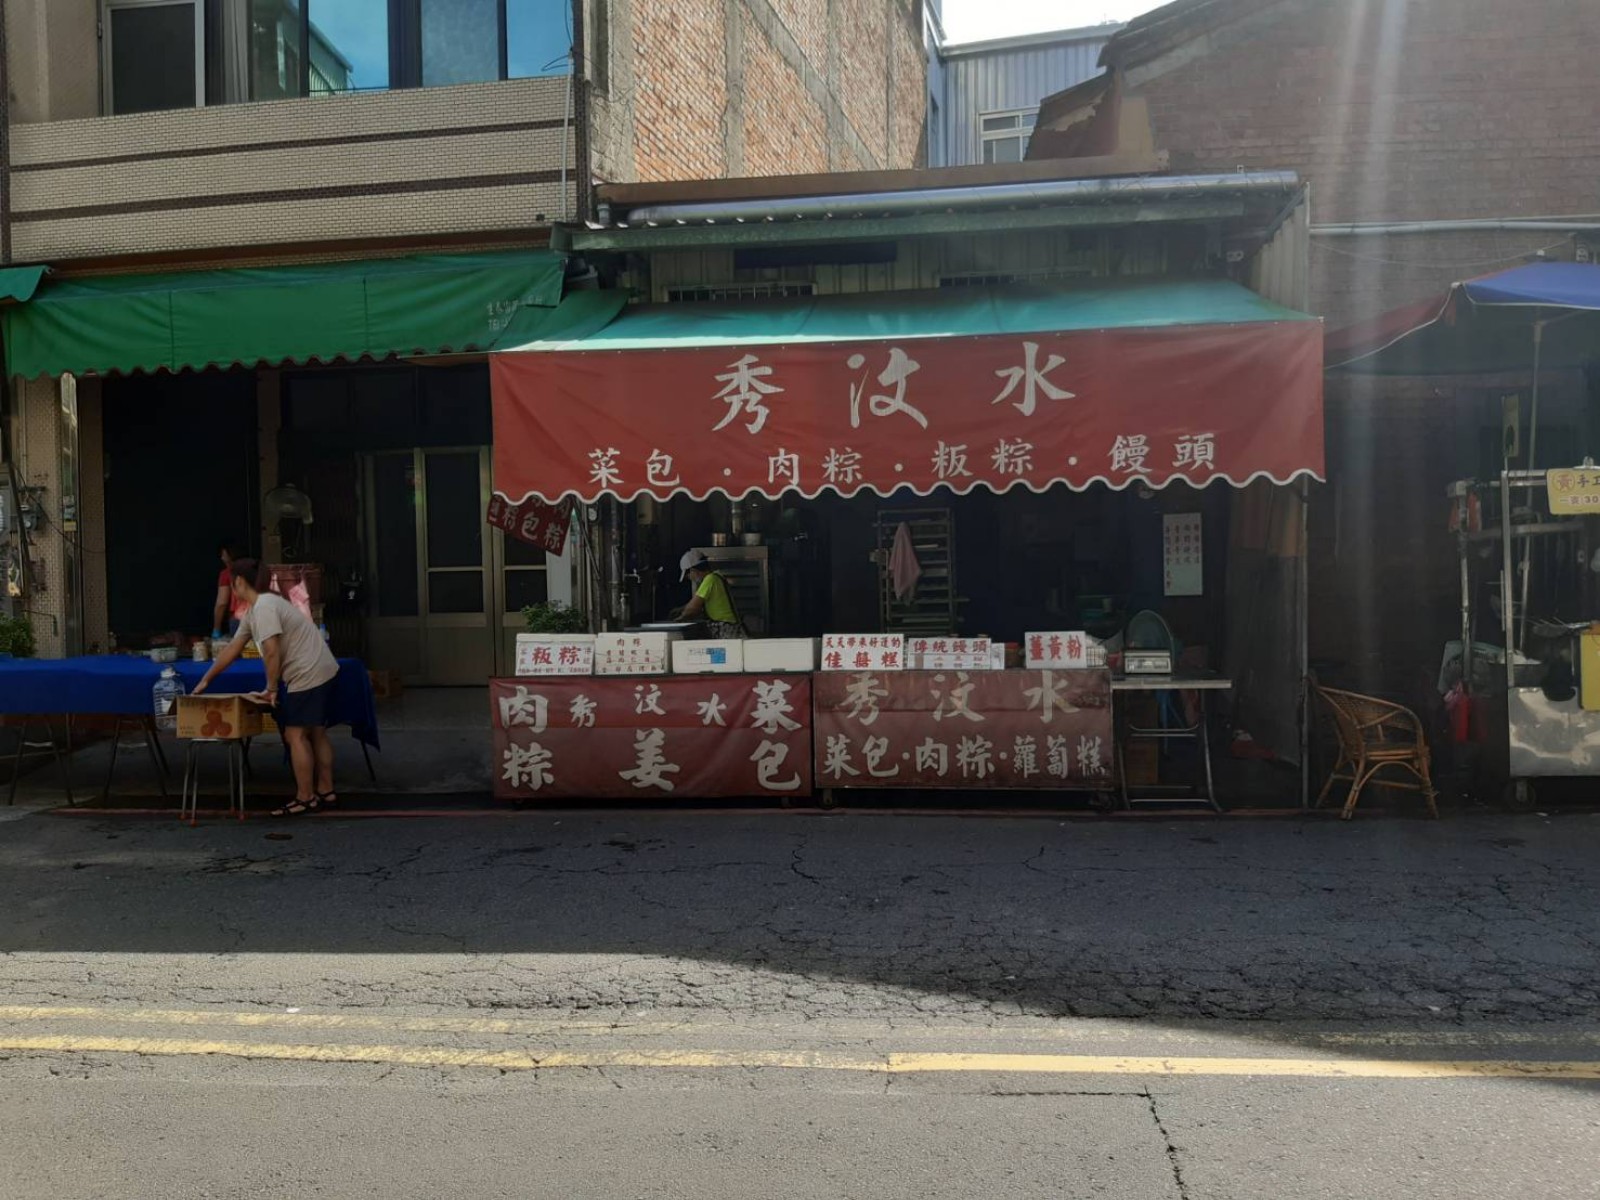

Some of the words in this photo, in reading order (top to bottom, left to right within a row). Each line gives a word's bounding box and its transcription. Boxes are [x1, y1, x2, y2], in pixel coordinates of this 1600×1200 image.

[1029, 634, 1083, 662] 薑黃粉
[569, 683, 728, 730] 秀汶水
[840, 670, 1081, 727] 秀汶水
[498, 685, 556, 791] 肉粽
[749, 678, 802, 791] 菜包
